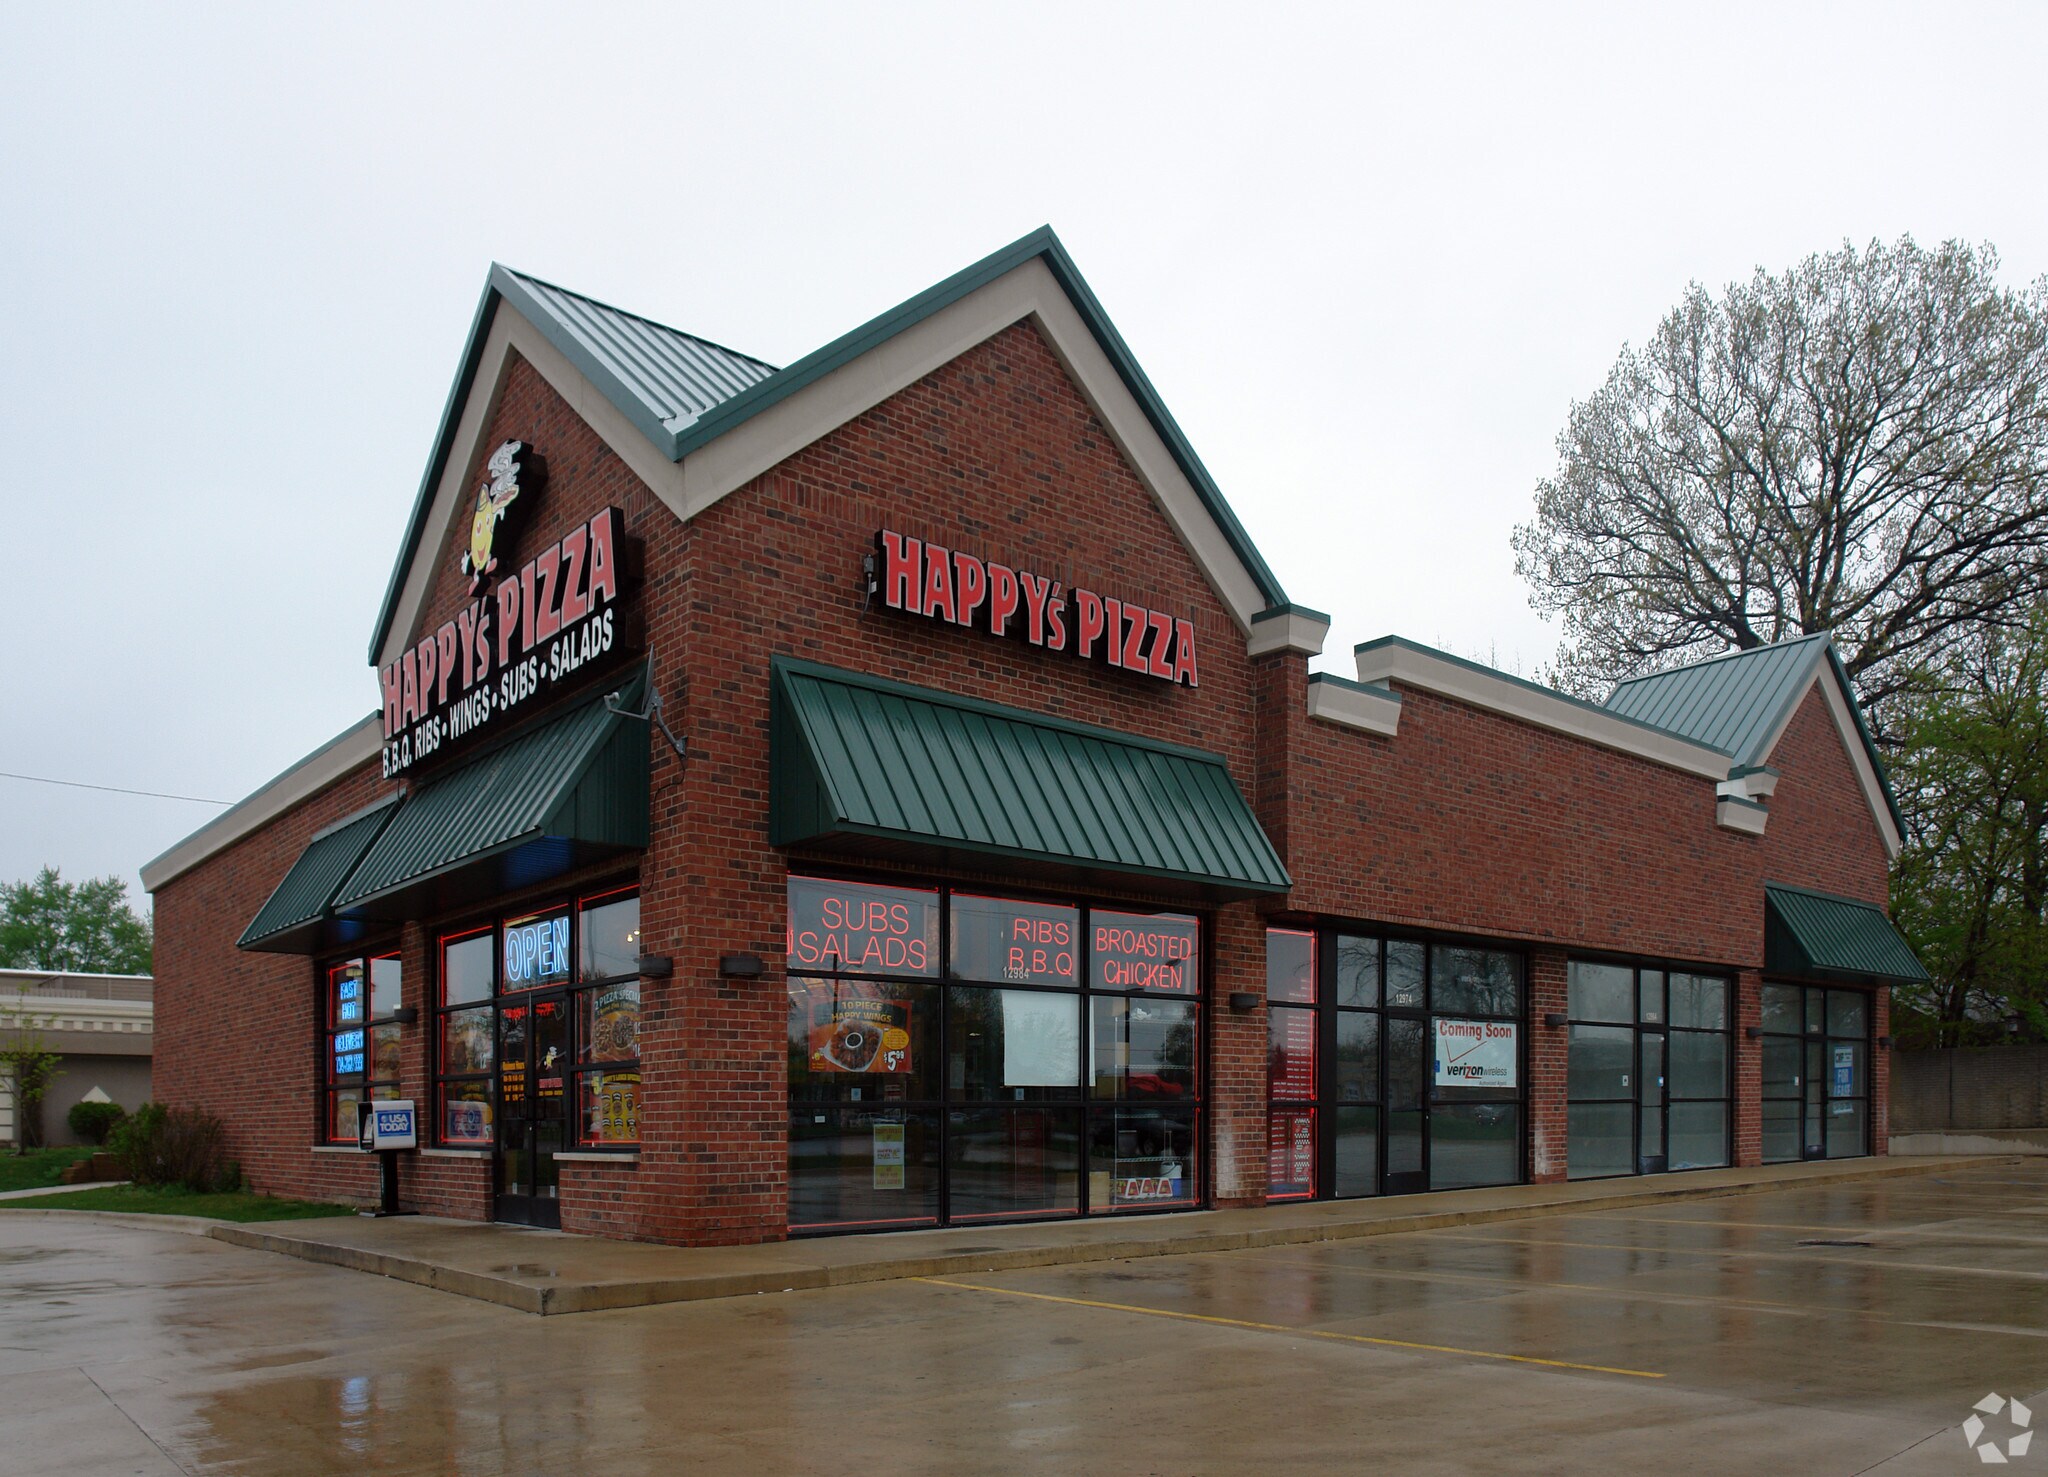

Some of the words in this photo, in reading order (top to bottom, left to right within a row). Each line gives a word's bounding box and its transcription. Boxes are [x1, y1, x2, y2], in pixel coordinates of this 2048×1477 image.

[497, 506, 617, 668] PIZZA
[1076, 587, 1198, 688] PIZZA
[383, 734, 412, 779] B.B.Q.
[415, 714, 440, 760] RIBS
[450, 684, 490, 740] WINGS
[500, 655, 537, 711] SUBS
[550, 608, 613, 682] SALADS
[822, 898, 909, 935] SUBS
[1013, 918, 1070, 945] RIBS
[506, 916, 569, 982] OPEN
[797, 931, 927, 969] SALADS
[1096, 927, 1192, 960] BROASTED
[1003, 966, 1030, 979] 12984
[1104, 960, 1183, 988] CHICKEN
[340, 980, 358, 1000] FAST
[599, 990, 618, 1007] PIZZA
[342, 1001, 357, 1020] HOT
[831, 1011, 861, 1021] HAPPY
[863, 1012, 892, 1022] WINGS
[842, 1001, 854, 1010] 10
[855, 1001, 884, 1011] PIECE
[1440, 1020, 1482, 1041] Coming
[1485, 1023, 1512, 1038] Soon
[335, 1031, 364, 1053] DELIVERY
[1447, 1062, 1484, 1079] verizon
[1484, 1066, 1508, 1077] wireless
[380, 1122, 409, 1132] TODAY
[389, 1113, 408, 1123] USA
